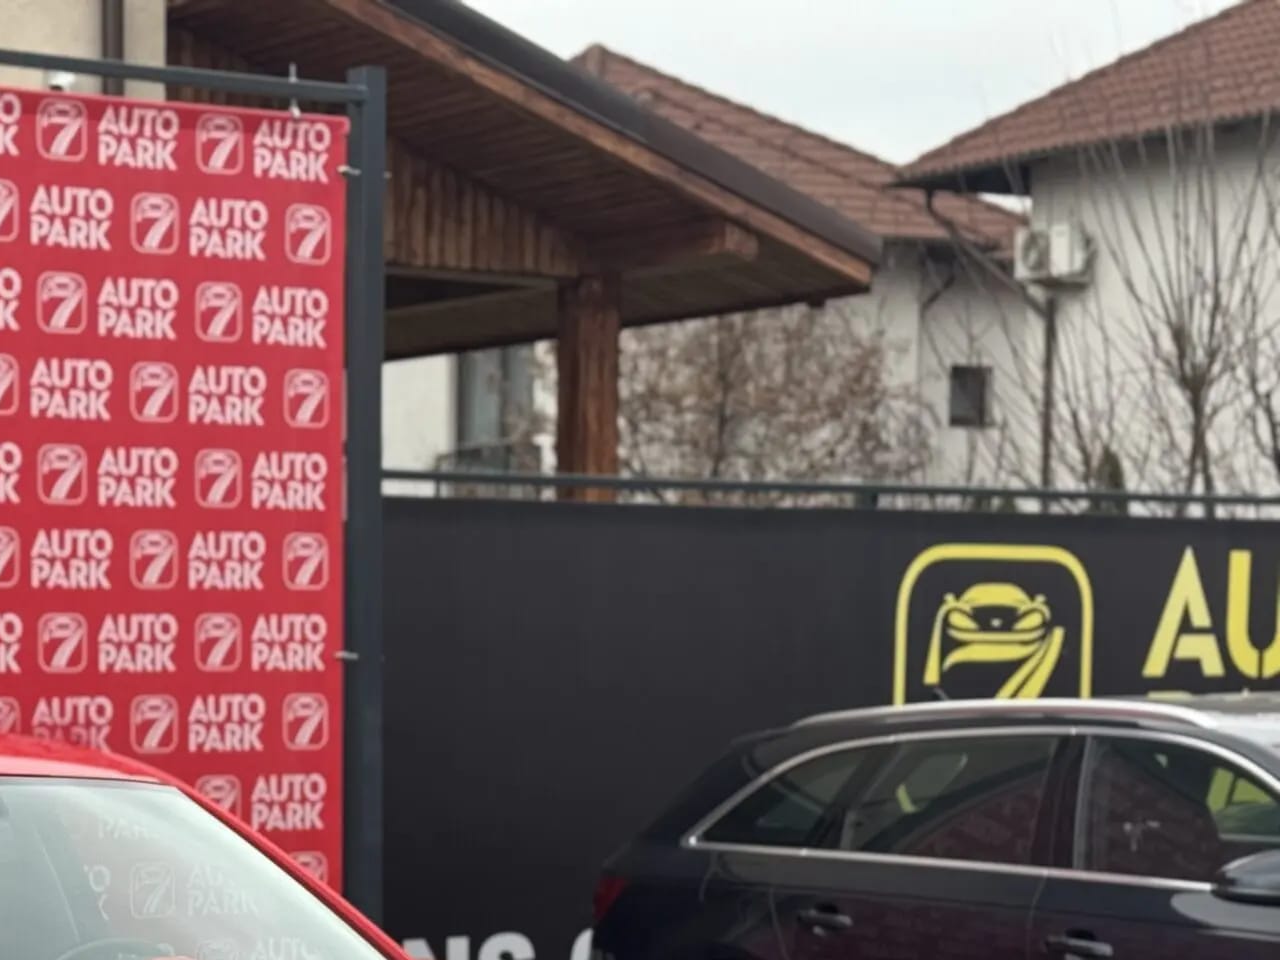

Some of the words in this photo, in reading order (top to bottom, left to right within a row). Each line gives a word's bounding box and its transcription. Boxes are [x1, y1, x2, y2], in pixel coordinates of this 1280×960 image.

[98, 105, 179, 141] AUTO
[253, 119, 330, 153] AUTO
[99, 133, 176, 170] PARK
[254, 146, 328, 182] PARK
[30, 186, 113, 220] AUTO
[190, 199, 268, 231] AUTO
[31, 214, 110, 250] PARK
[190, 225, 265, 260] PARK
[98, 278, 178, 310] AUTO
[253, 287, 328, 318] AUTO
[98, 306, 175, 339] PARK
[253, 313, 325, 348] PARK
[30, 358, 112, 390] AUTO
[189, 366, 266, 397] AUTO
[31, 386, 110, 420] PARK
[189, 393, 263, 425] PARK
[98, 448, 178, 478] AUTO
[252, 452, 327, 482] AUTO
[98, 476, 175, 507] PARK
[252, 480, 324, 510] PARK
[31, 529, 113, 559] AUTO
[189, 532, 265, 561] AUTO
[31, 558, 110, 589] PARK
[189, 559, 263, 589] PARK
[98, 613, 178, 643] AUTO
[252, 614, 327, 642] AUTO
[99, 643, 175, 672] PARK
[252, 641, 324, 671] PARK
[32, 697, 114, 728] AUTO
[189, 694, 265, 723] AUTO
[189, 723, 263, 752] PARK
[252, 773, 326, 803] AUTO
[252, 801, 323, 831] PARK
